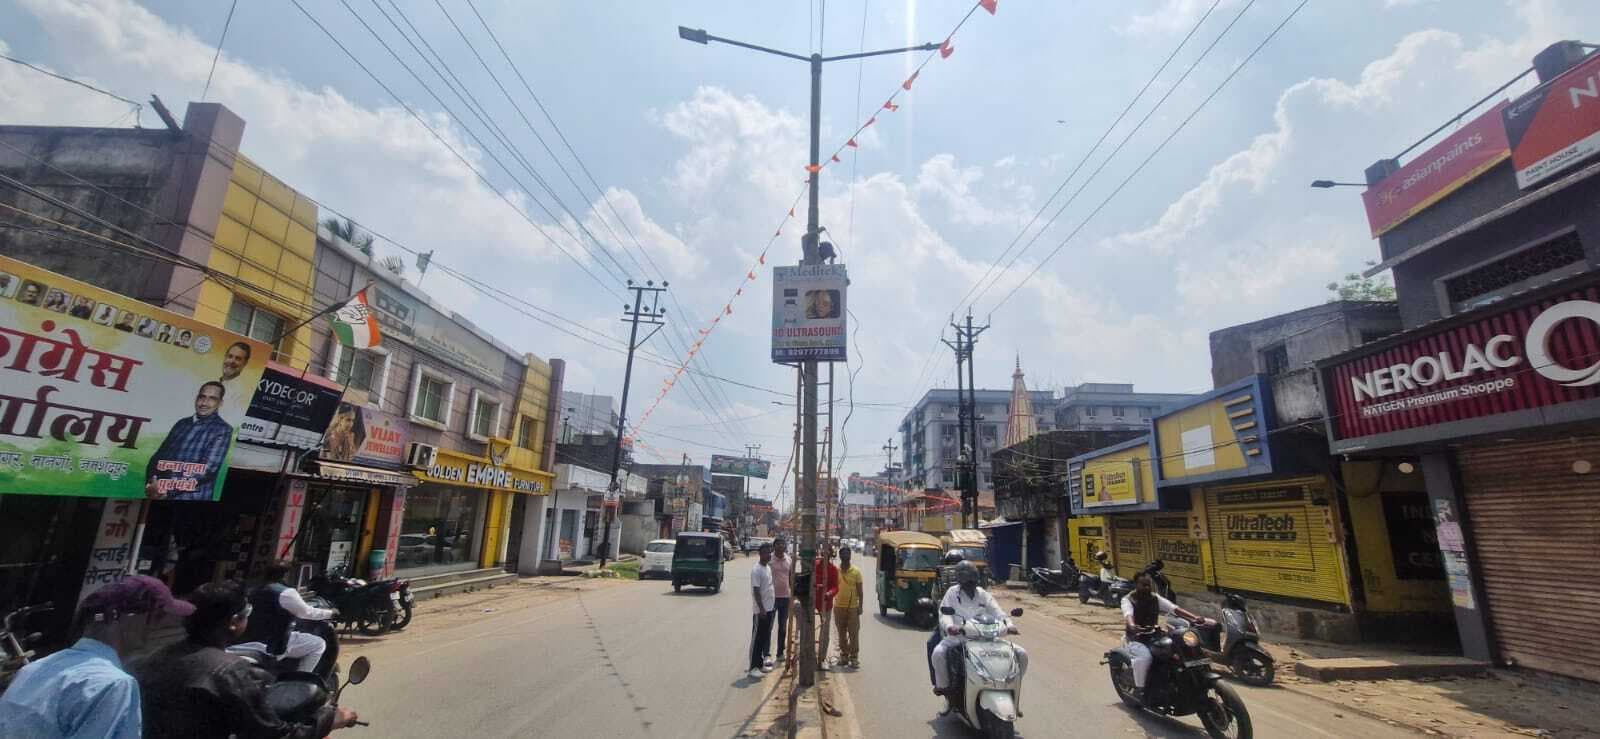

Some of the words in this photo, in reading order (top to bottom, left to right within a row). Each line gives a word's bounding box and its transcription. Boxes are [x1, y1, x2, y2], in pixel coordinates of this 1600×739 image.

[1402, 132, 1483, 190] asianpaints
[0, 319, 143, 392] ांग्रेस
[1350, 333, 1520, 402] NEROLAC
[1407, 388, 1459, 408] Premium
[1459, 377, 1515, 397] Shoppe
[240, 420, 264, 433] entre
[371, 425, 401, 443] VIJAY
[467, 463, 512, 488] EMPIRE
[1226, 514, 1295, 531] UltraTech
